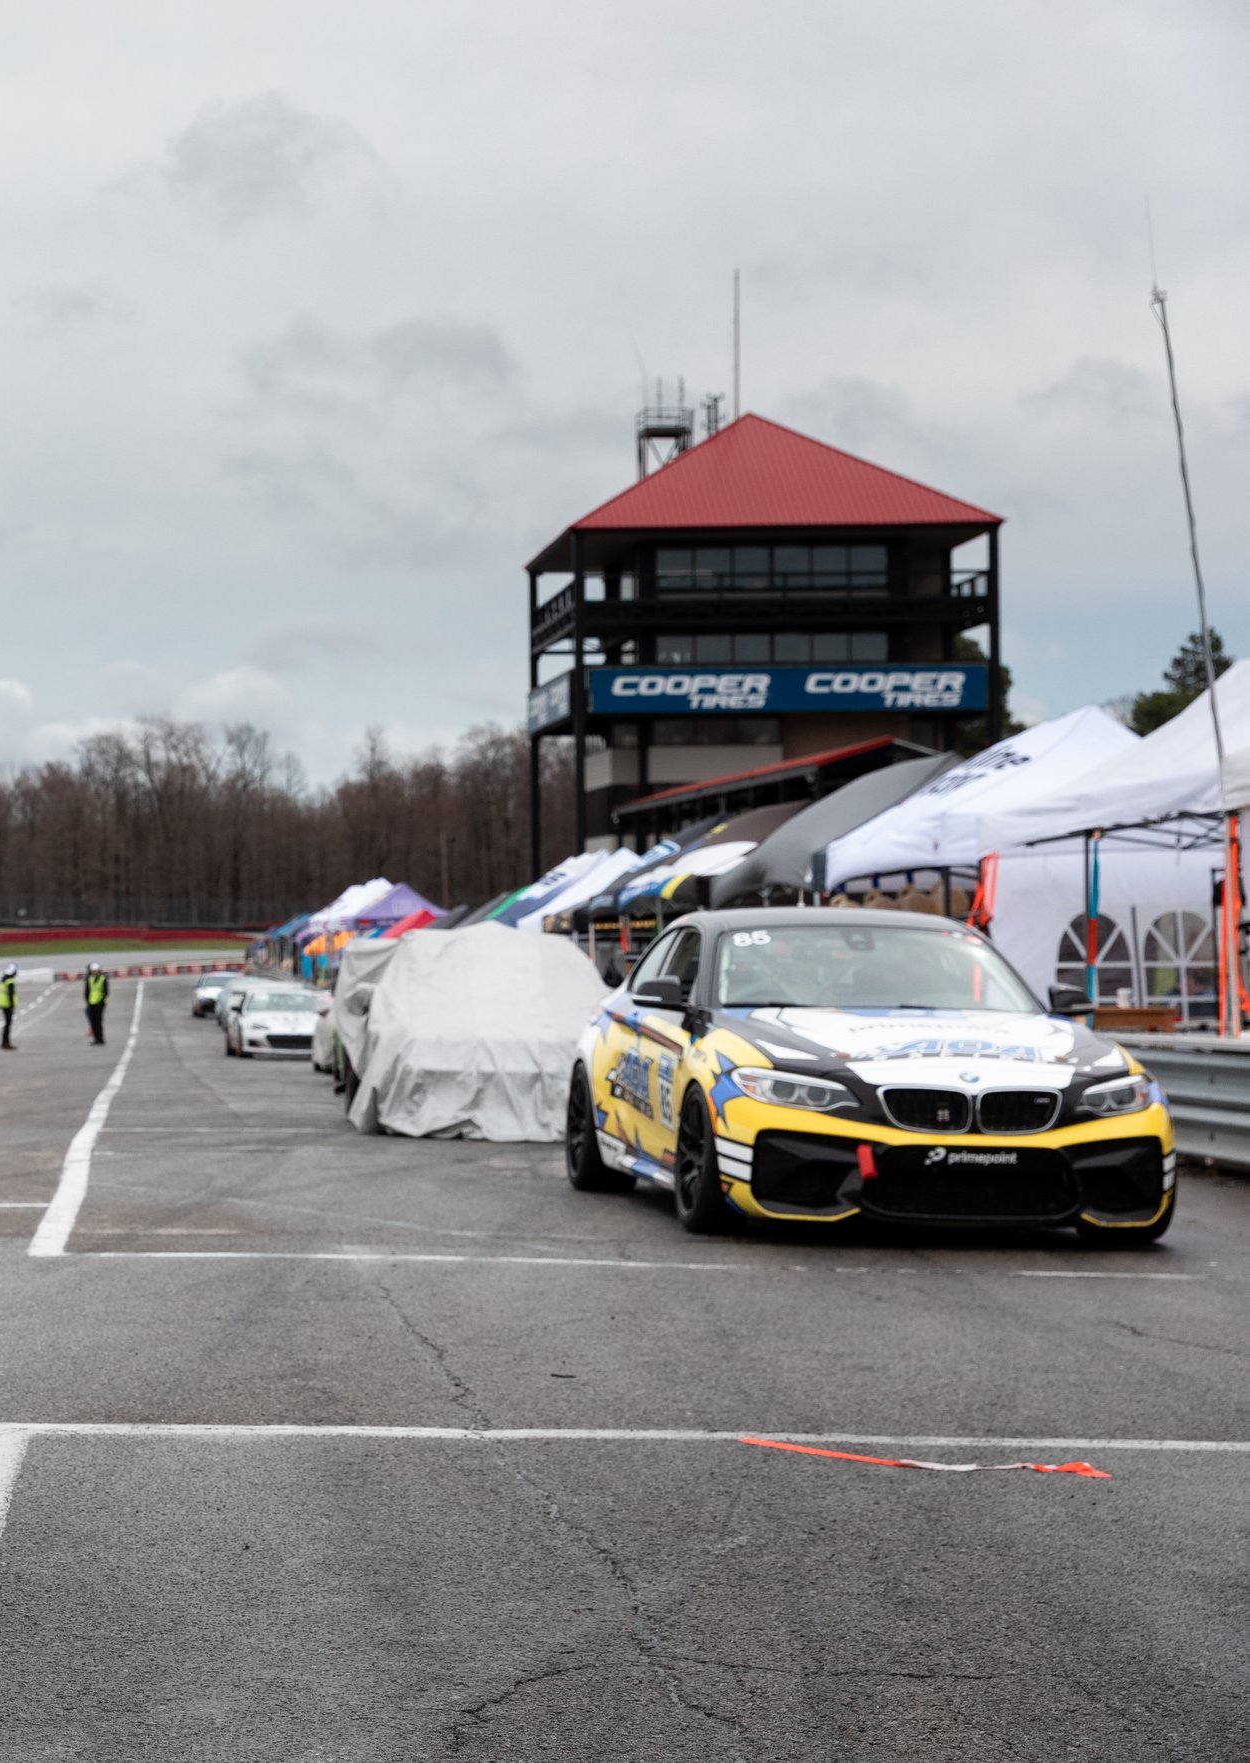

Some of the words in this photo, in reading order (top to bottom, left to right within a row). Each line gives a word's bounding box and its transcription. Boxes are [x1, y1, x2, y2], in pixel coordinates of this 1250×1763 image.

[611, 674, 771, 696] COOPER
[804, 672, 966, 693] COOPER
[688, 694, 767, 709] TIRES
[882, 691, 962, 707] TIRES
[948, 1150, 1018, 1166] primepoint
